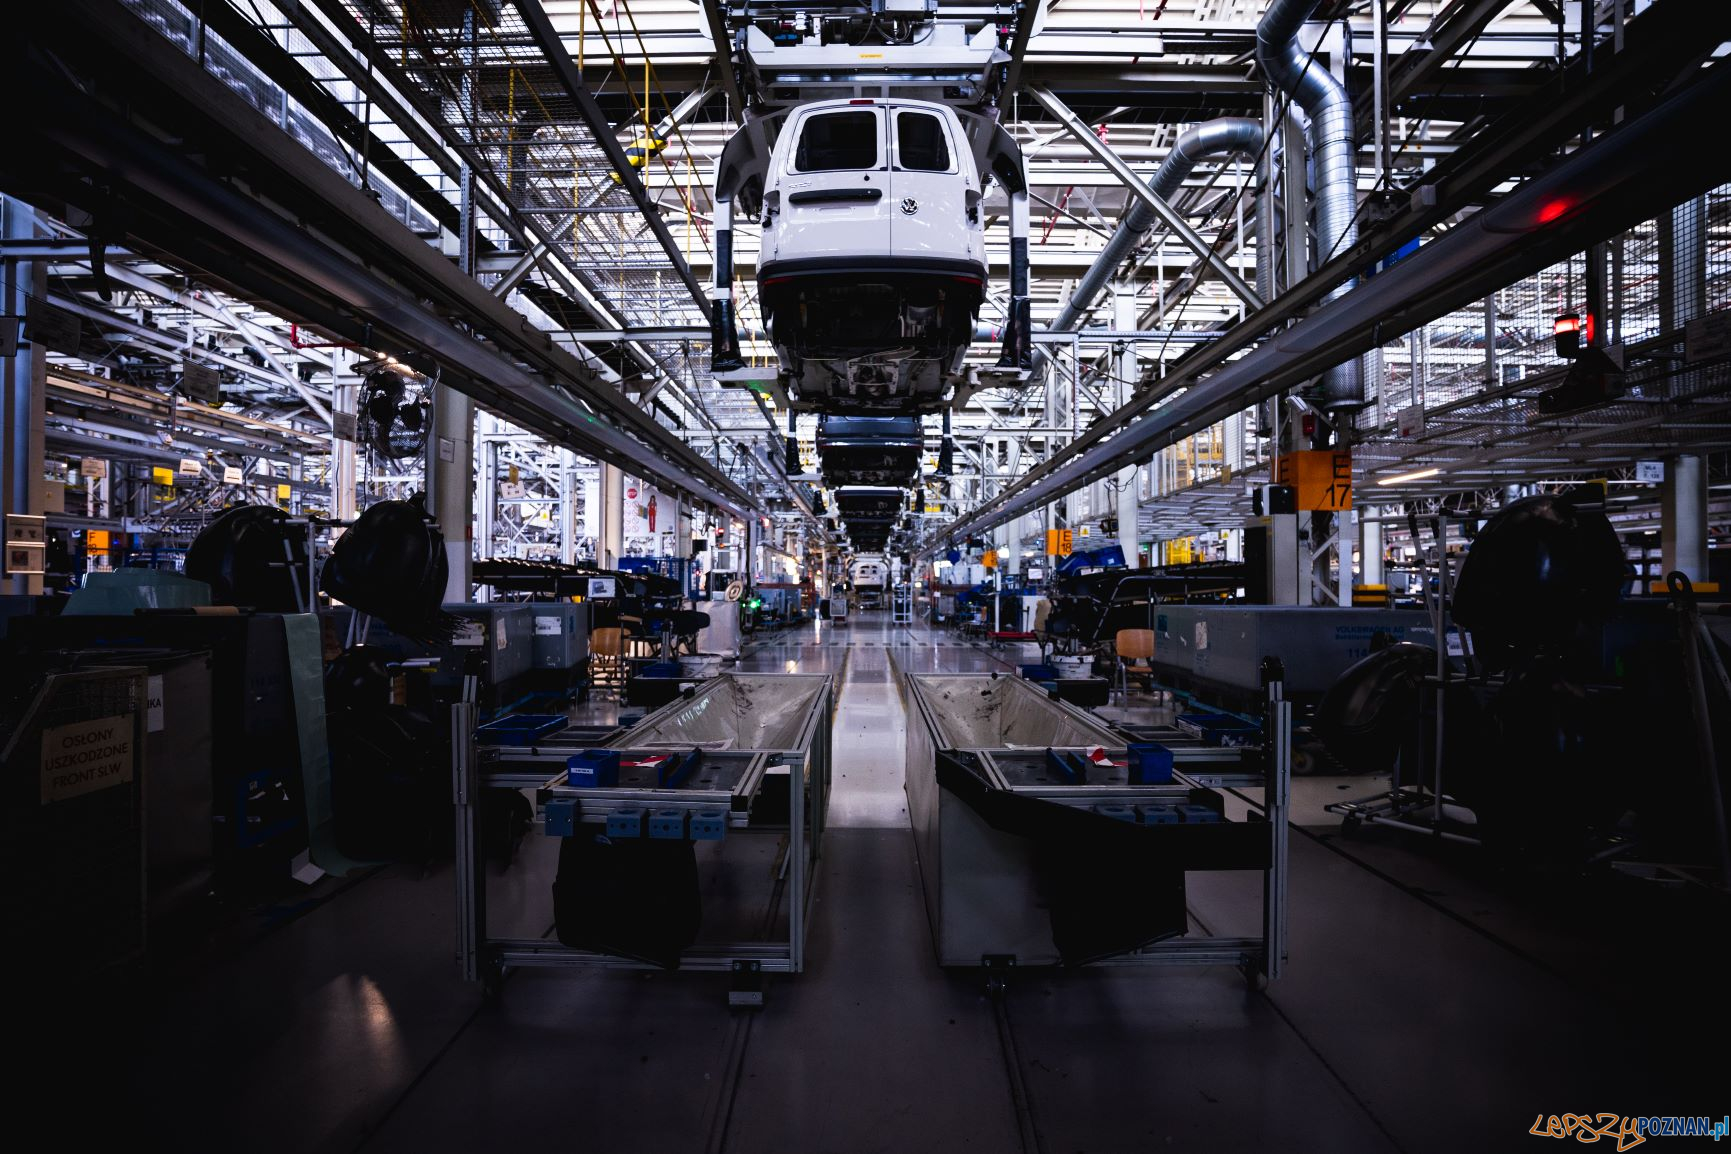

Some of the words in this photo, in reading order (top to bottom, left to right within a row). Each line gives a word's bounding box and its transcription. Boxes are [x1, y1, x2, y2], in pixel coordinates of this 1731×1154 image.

[1333, 454, 1350, 479] E
[1325, 483, 1351, 507] 17
[62, 728, 114, 748] OSŁONY
[45, 742, 129, 771] USZKODZONE
[53, 768, 97, 788] FRONT
